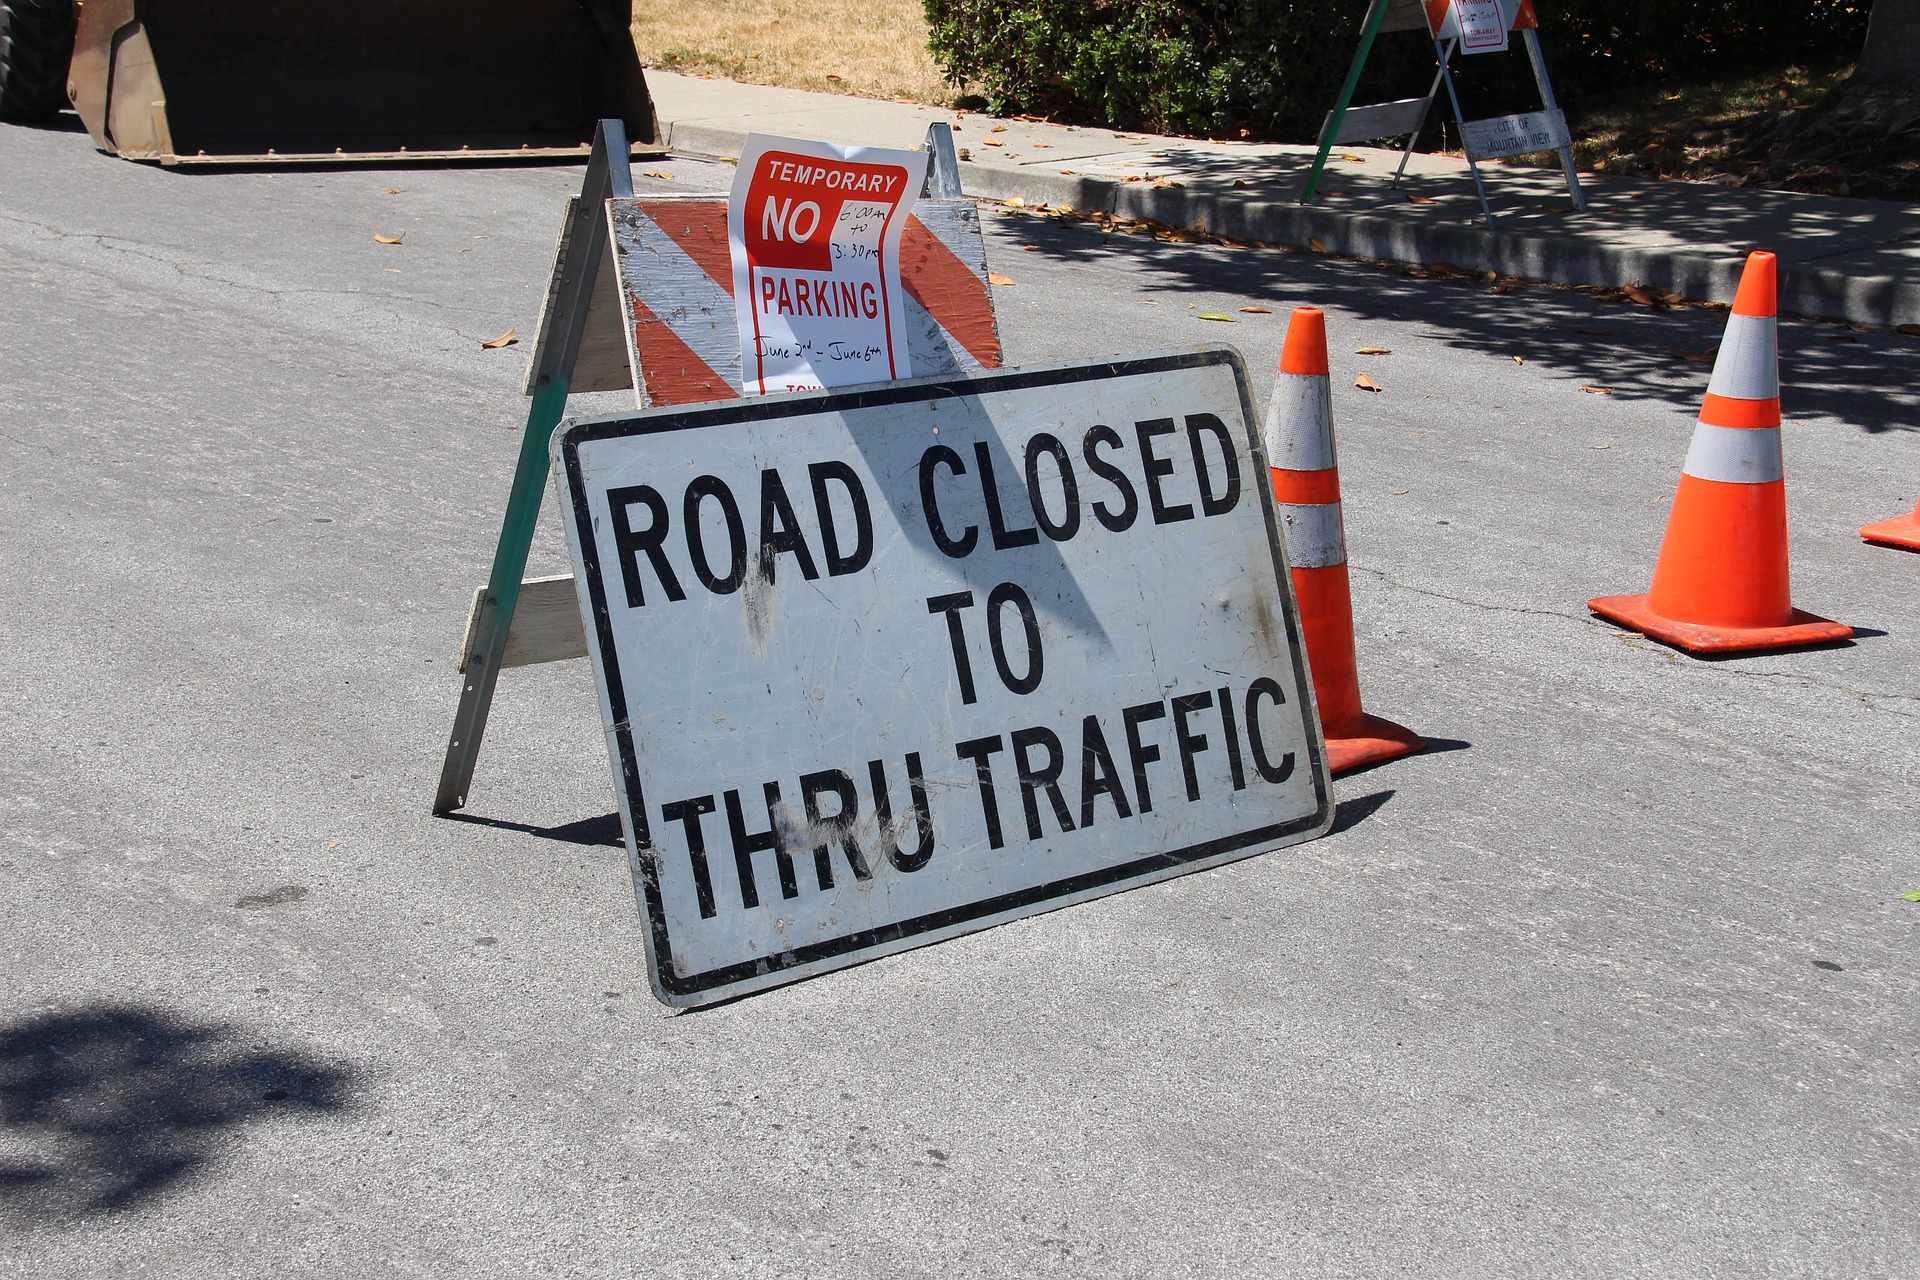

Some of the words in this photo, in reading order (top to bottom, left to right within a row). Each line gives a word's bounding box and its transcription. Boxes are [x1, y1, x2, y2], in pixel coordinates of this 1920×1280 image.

[1519, 117, 1529, 130] OF
[1530, 131, 1551, 146] VIEW
[768, 159, 898, 194] TEMPORARY
[761, 195, 822, 244] NO
[850, 223, 868, 235] to
[761, 275, 879, 320] PARKING
[753, 335, 790, 360] June
[828, 341, 861, 361] June
[606, 460, 875, 608] ROAD
[918, 411, 1242, 559] CLOSED
[927, 581, 1045, 705] TO
[662, 752, 935, 919] THRU
[958, 677, 1297, 849] TRAFFIC
